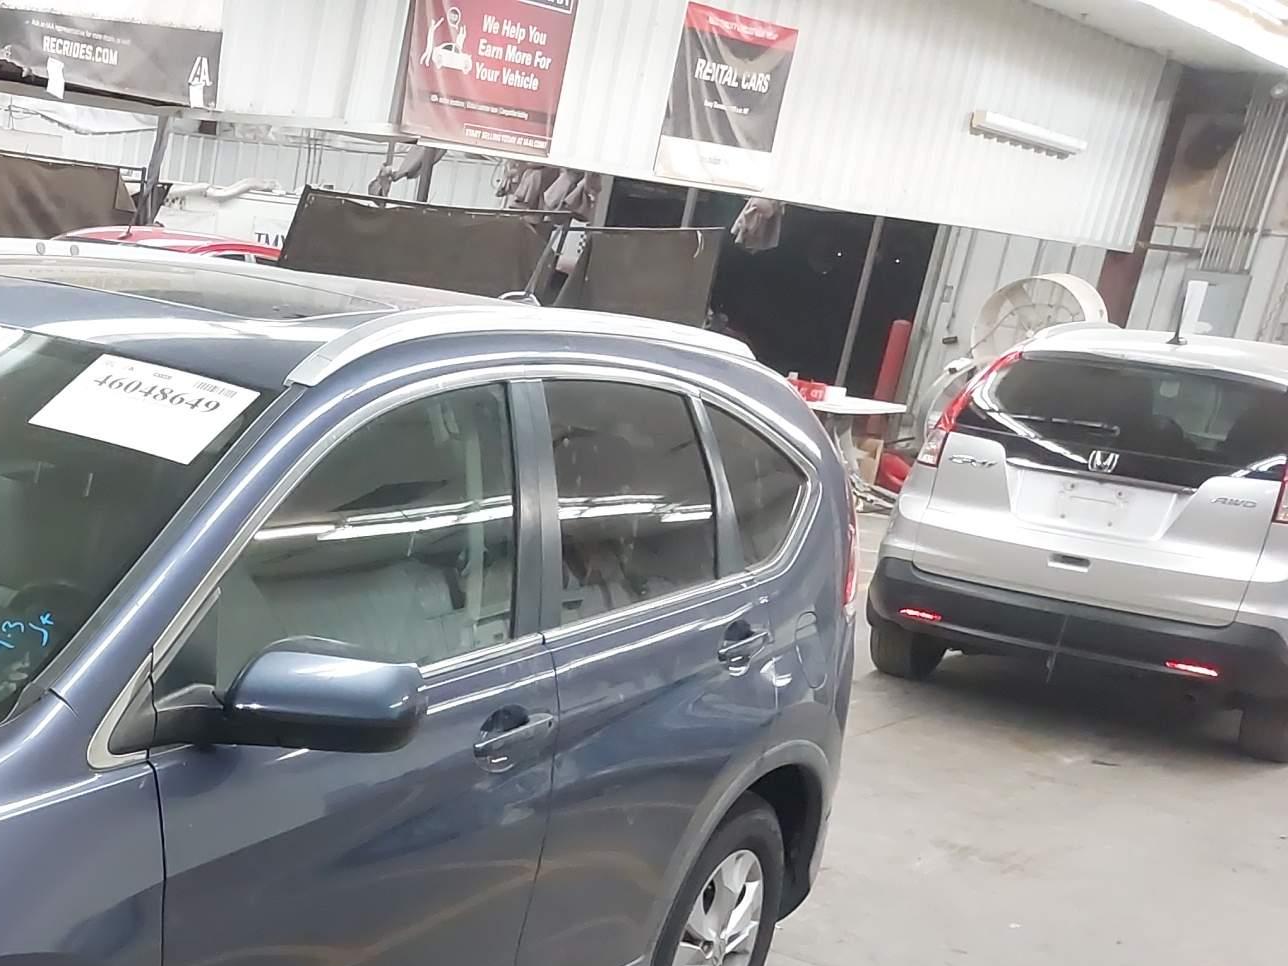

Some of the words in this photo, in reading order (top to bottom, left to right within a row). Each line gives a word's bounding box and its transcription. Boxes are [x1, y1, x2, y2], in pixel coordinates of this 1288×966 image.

[483, 14, 499, 34] We
[501, 18, 526, 43] Help
[528, 25, 547, 45] You
[43, 35, 118, 65] RECRIDES.COM
[478, 38, 503, 59] Earn
[504, 46, 531, 66] More
[533, 51, 551, 70] For
[475, 62, 500, 82] Your
[502, 67, 540, 91] Vehicle
[694, 57, 739, 87] RENTAL
[741, 72, 771, 94] CARS
[94, 375, 221, 413] 46048649
